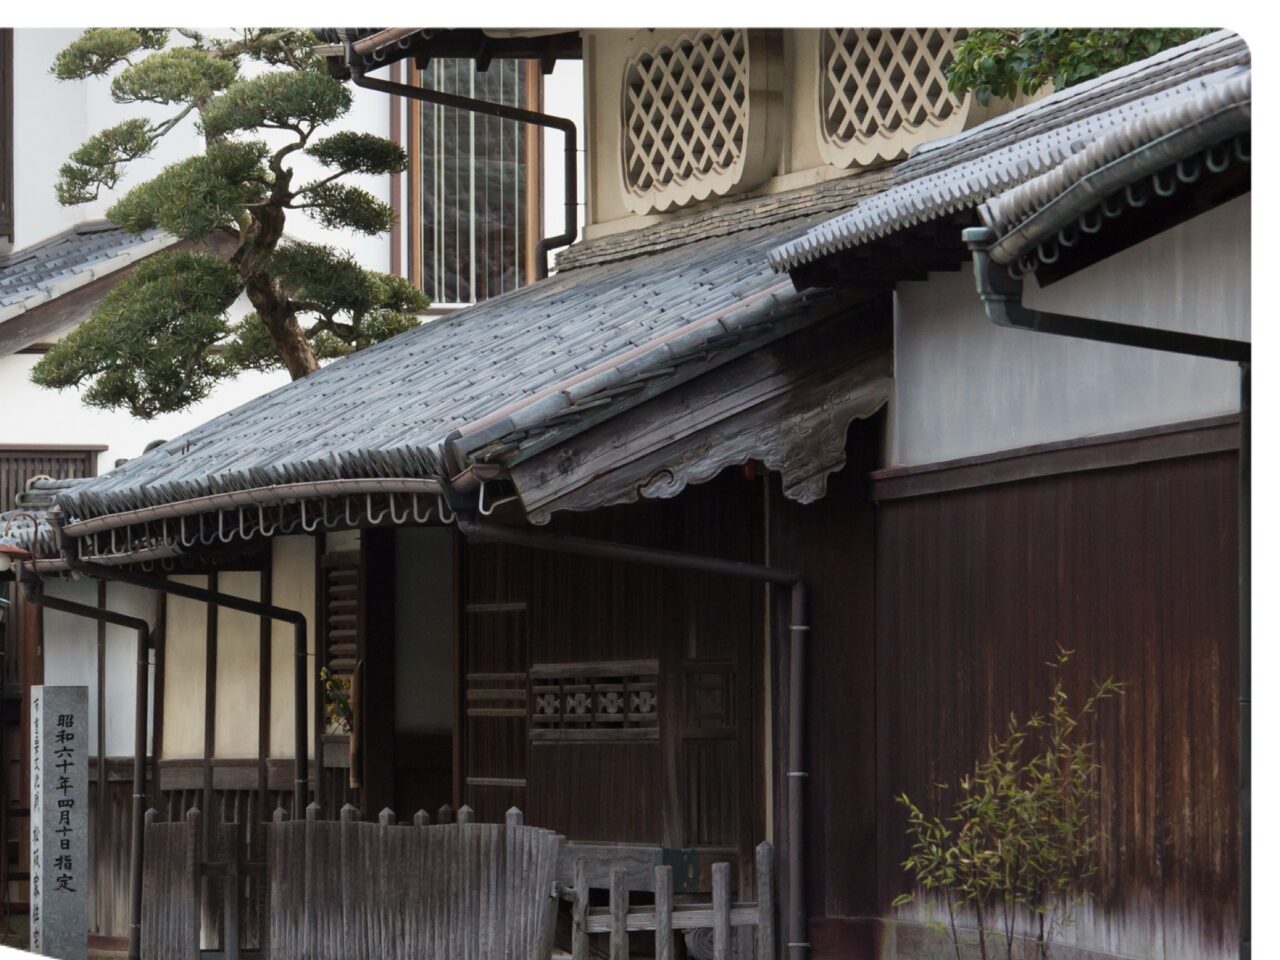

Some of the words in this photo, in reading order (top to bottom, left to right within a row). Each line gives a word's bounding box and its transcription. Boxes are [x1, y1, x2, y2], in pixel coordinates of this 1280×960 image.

[53, 714, 76, 892] 昭和六十年四月十日指定
